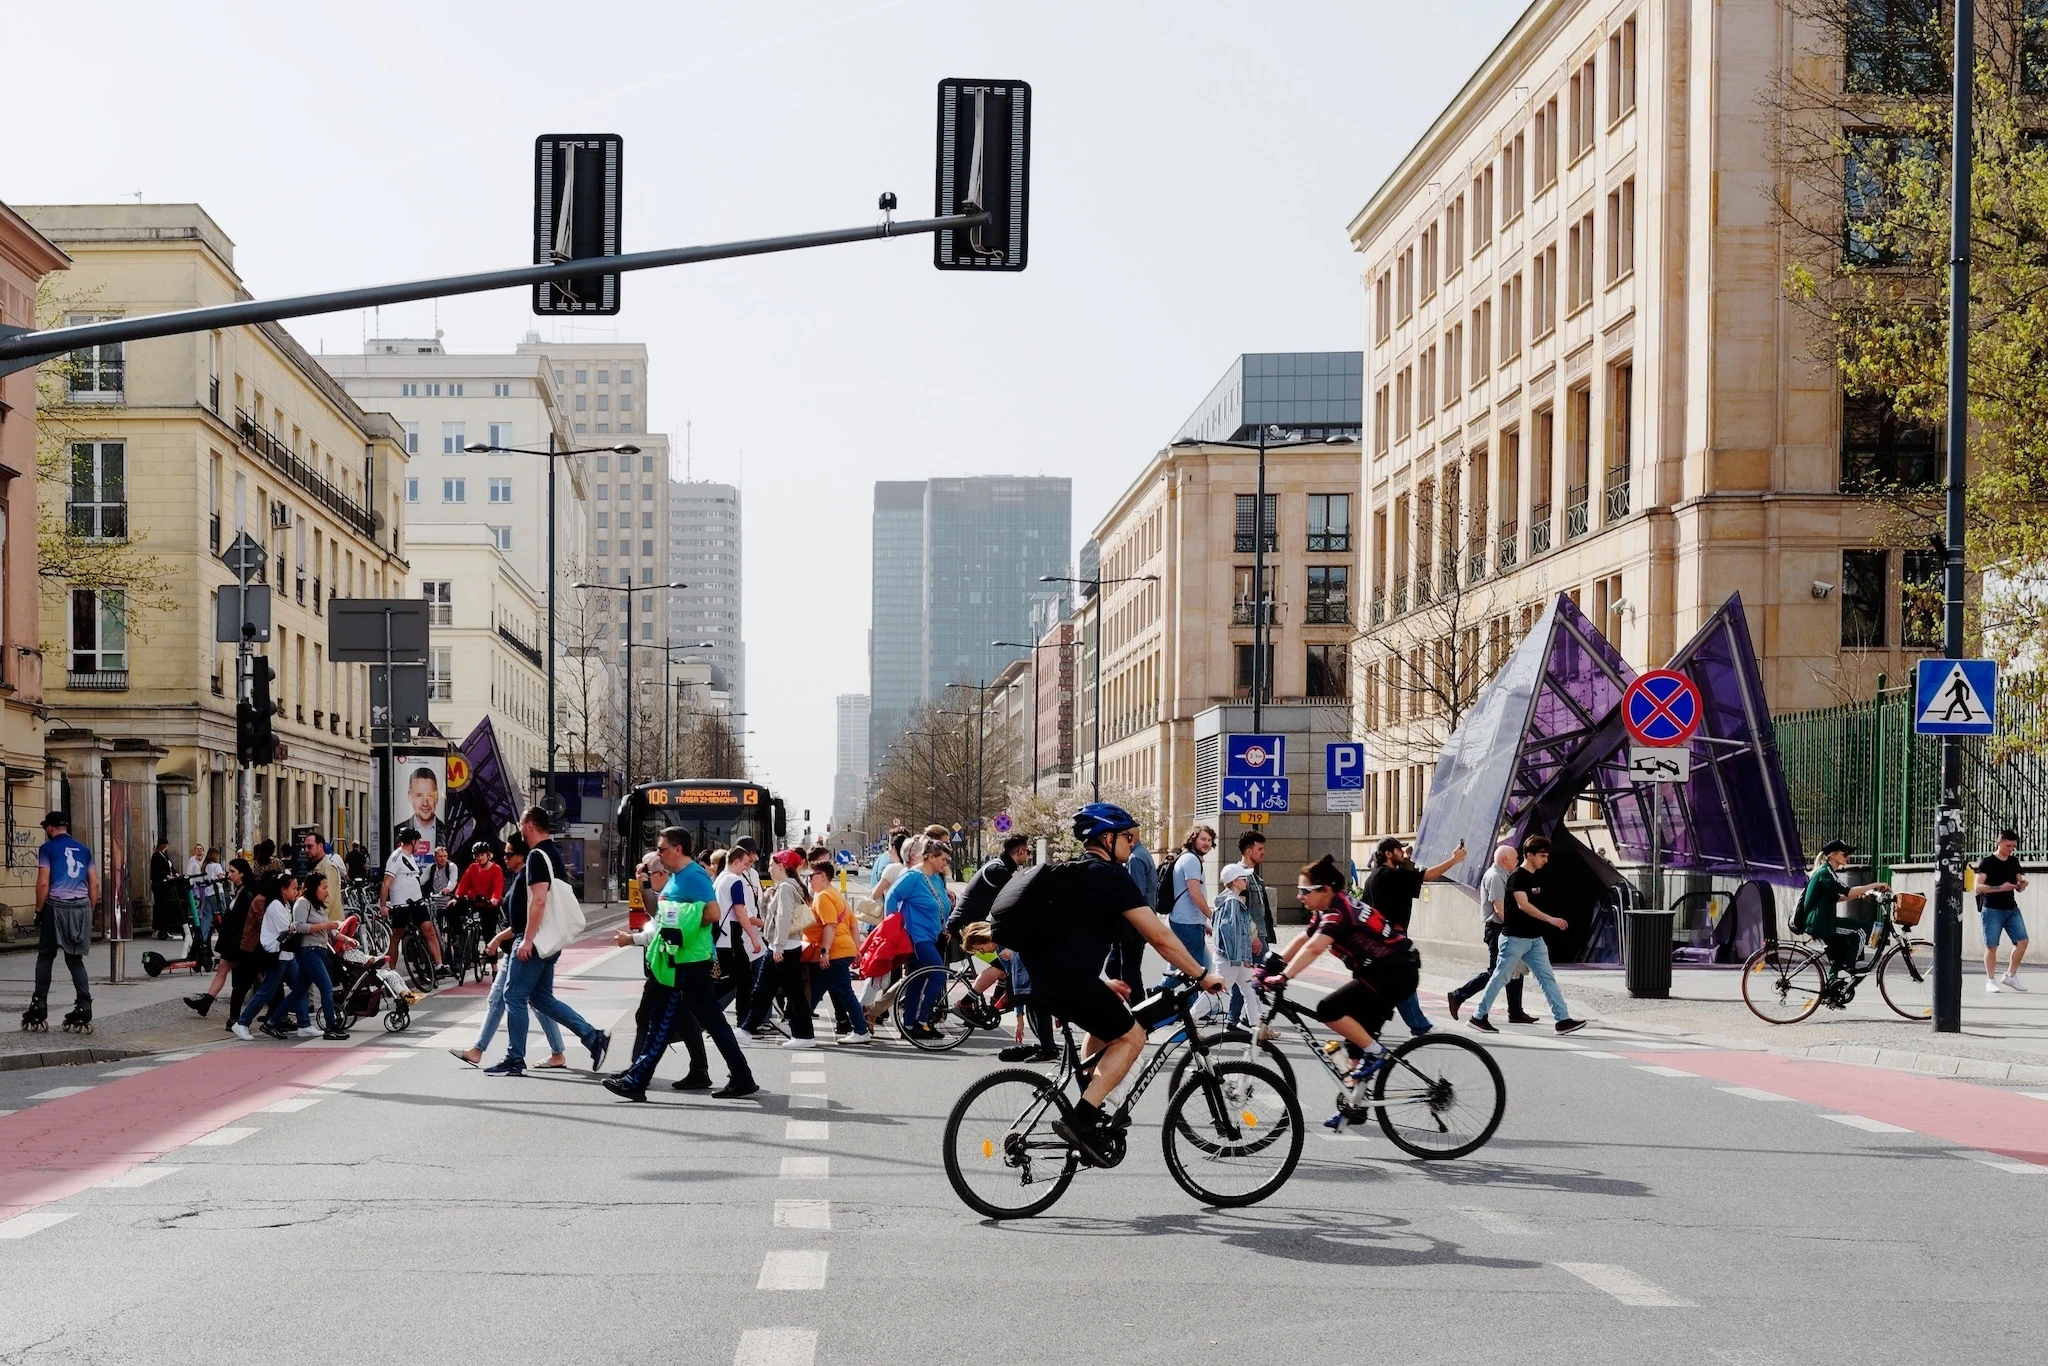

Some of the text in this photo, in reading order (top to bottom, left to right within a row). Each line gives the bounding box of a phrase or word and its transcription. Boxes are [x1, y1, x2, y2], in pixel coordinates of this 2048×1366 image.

[1335, 747, 1357, 776] P
[647, 789, 668, 805] 106
[680, 789, 732, 797] MARIENSZTAT
[675, 796, 738, 804] TRASA ZMIENIONA
[1248, 813, 1263, 822] 719
